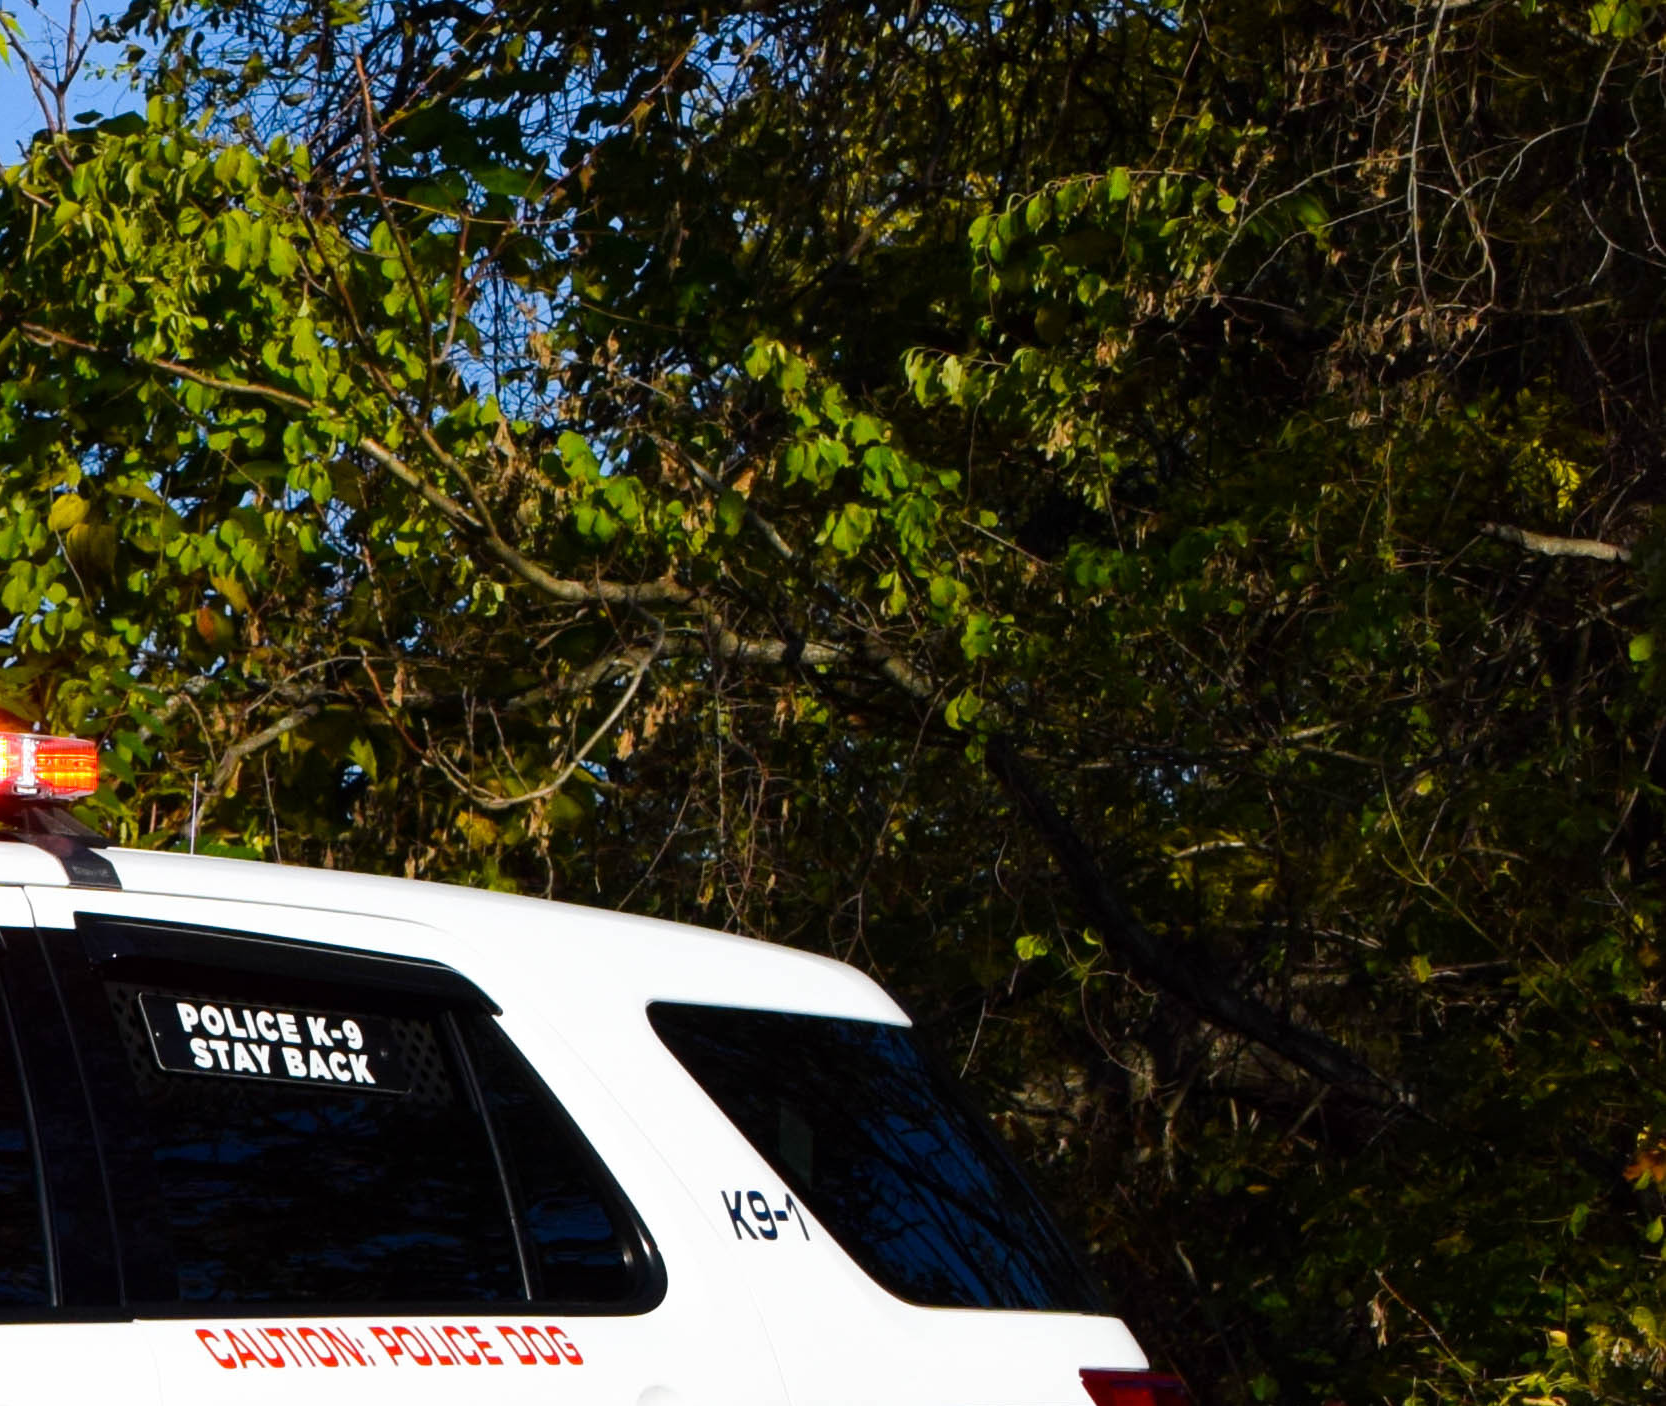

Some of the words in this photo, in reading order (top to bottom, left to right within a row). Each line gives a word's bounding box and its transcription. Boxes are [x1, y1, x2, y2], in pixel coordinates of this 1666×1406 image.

[178, 1003, 301, 1047] POLICE
[311, 1015, 363, 1051] K-9
[192, 1037, 272, 1074] STAY
[282, 1047, 376, 1085] BACK
[721, 1190, 812, 1241] K9-1
[195, 1327, 373, 1371] CAUTION:
[374, 1325, 500, 1367] POLICE
[498, 1325, 584, 1366] DOG
